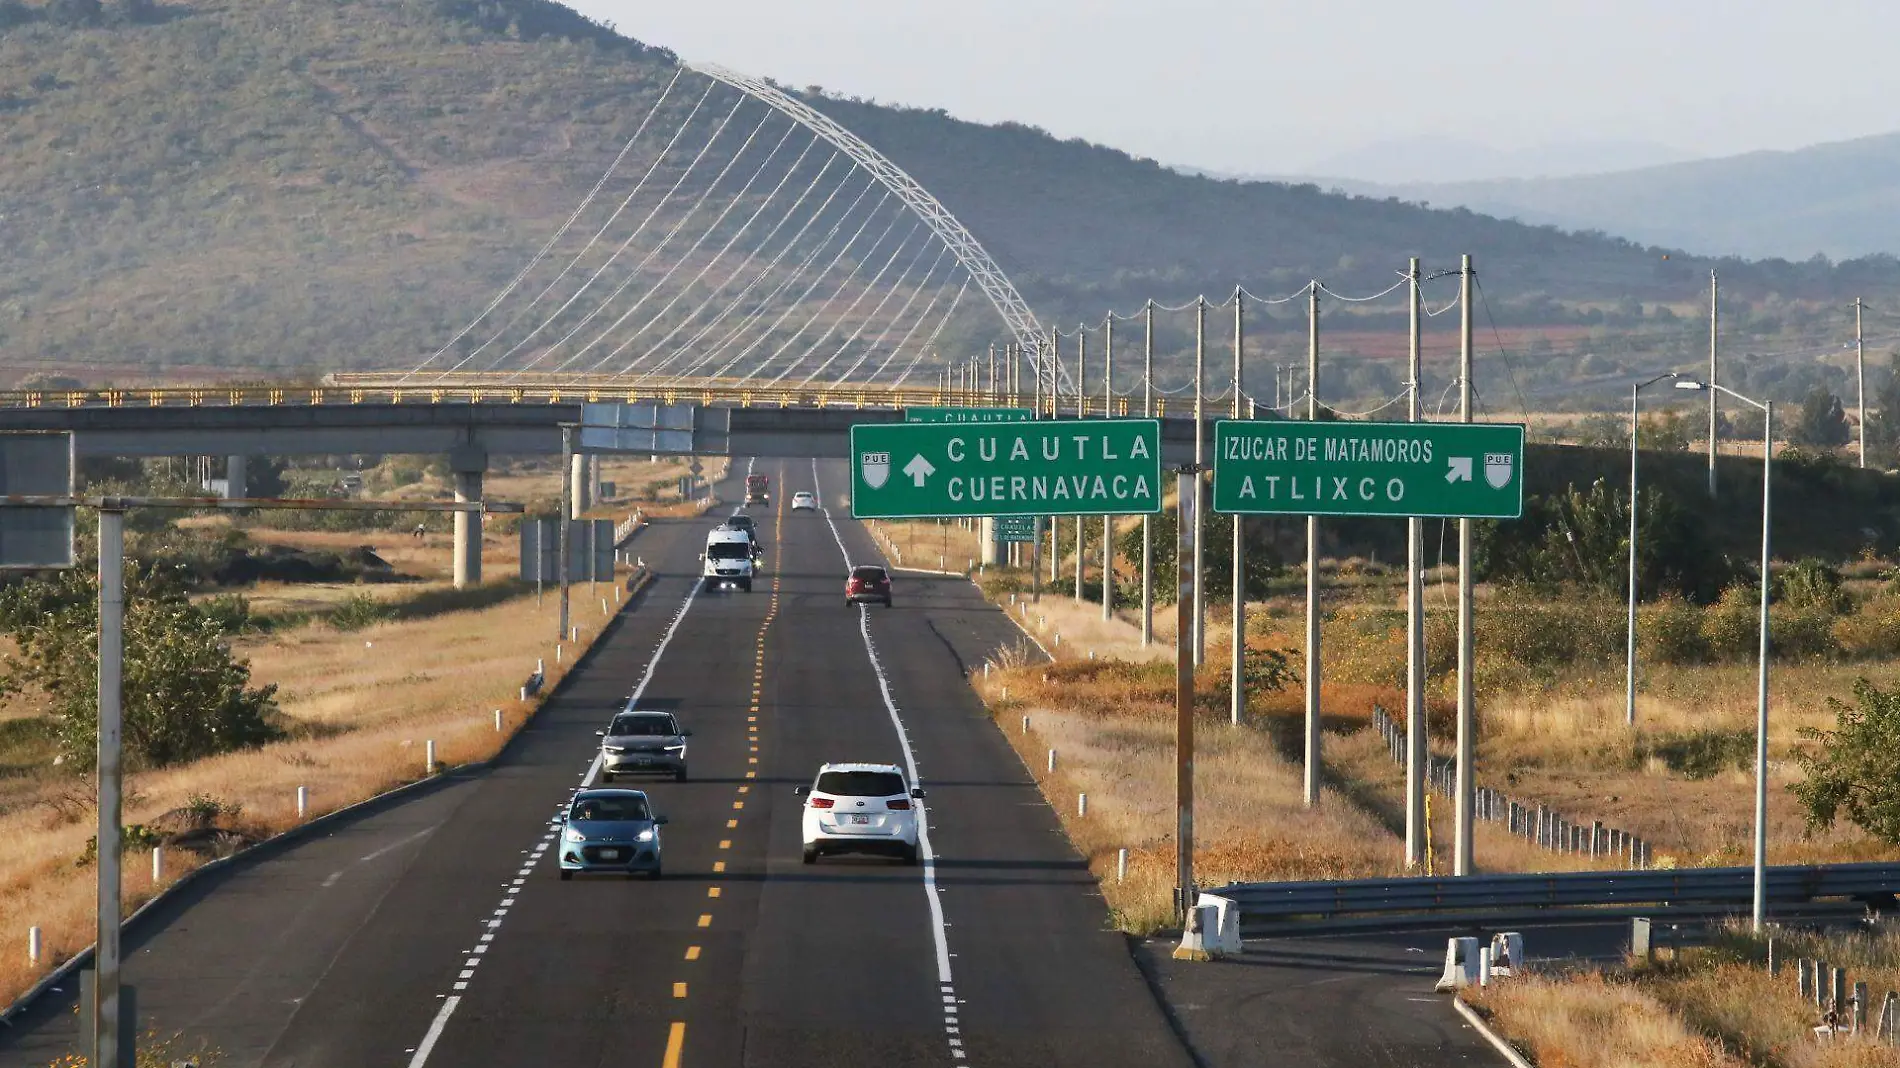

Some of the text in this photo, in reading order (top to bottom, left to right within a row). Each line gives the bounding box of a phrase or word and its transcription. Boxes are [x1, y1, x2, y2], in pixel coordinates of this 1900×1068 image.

[865, 455, 887, 463] PUE
[948, 435, 1150, 462] CUAUTLA
[1224, 436, 1433, 463] IZUCAR DE MATAMOROS
[1488, 455, 1510, 463] PUE
[948, 475, 1150, 501] CUERNAVACA
[1239, 475, 1404, 501] ATLIXCO
